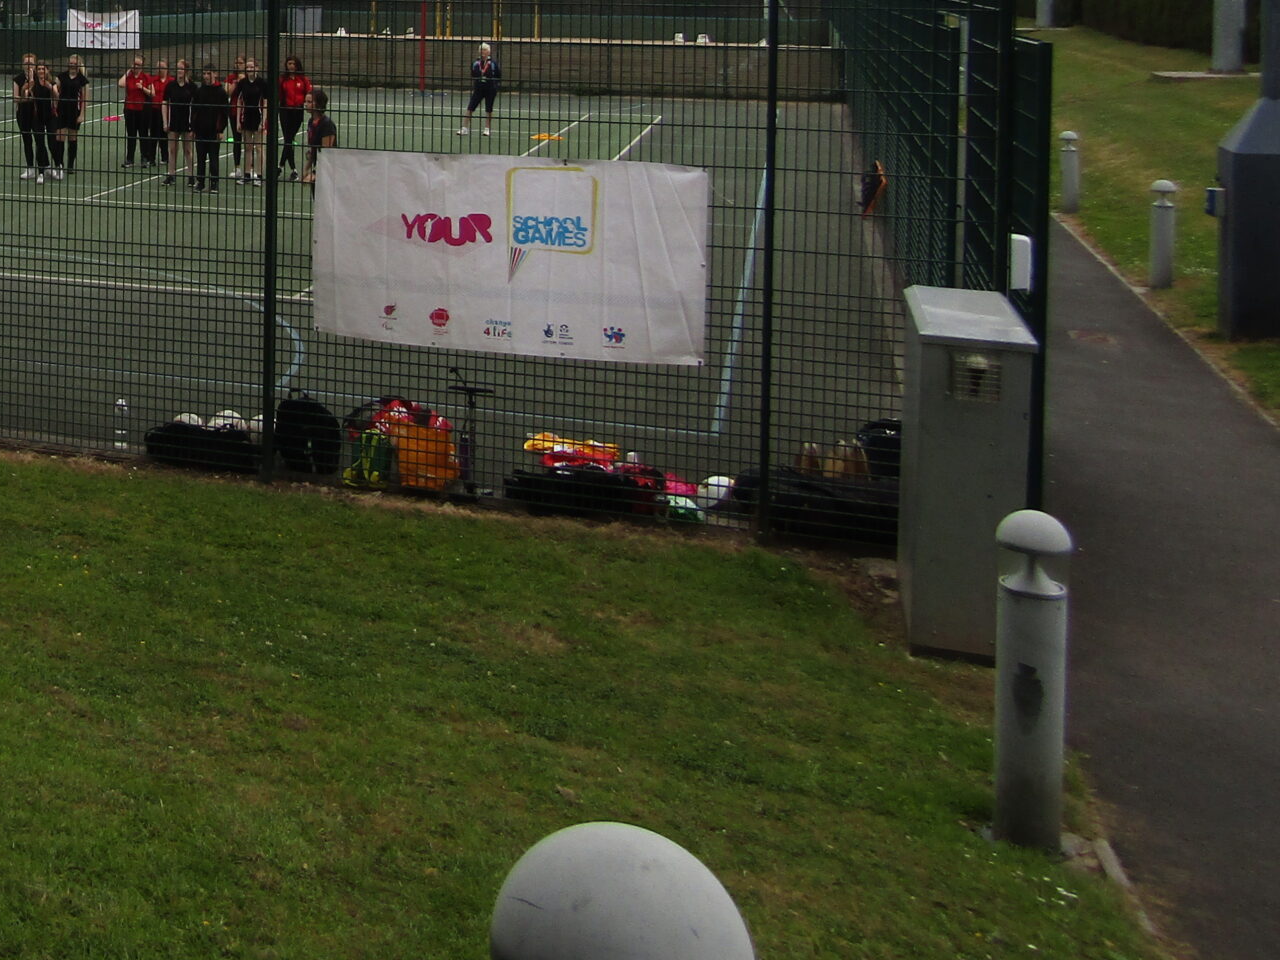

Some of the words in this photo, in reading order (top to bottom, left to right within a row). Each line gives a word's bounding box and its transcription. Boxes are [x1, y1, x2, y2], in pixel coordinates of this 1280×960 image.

[401, 213, 493, 246] YOUR
[512, 215, 587, 232] SCHOOL
[512, 229, 587, 248] GAMES
